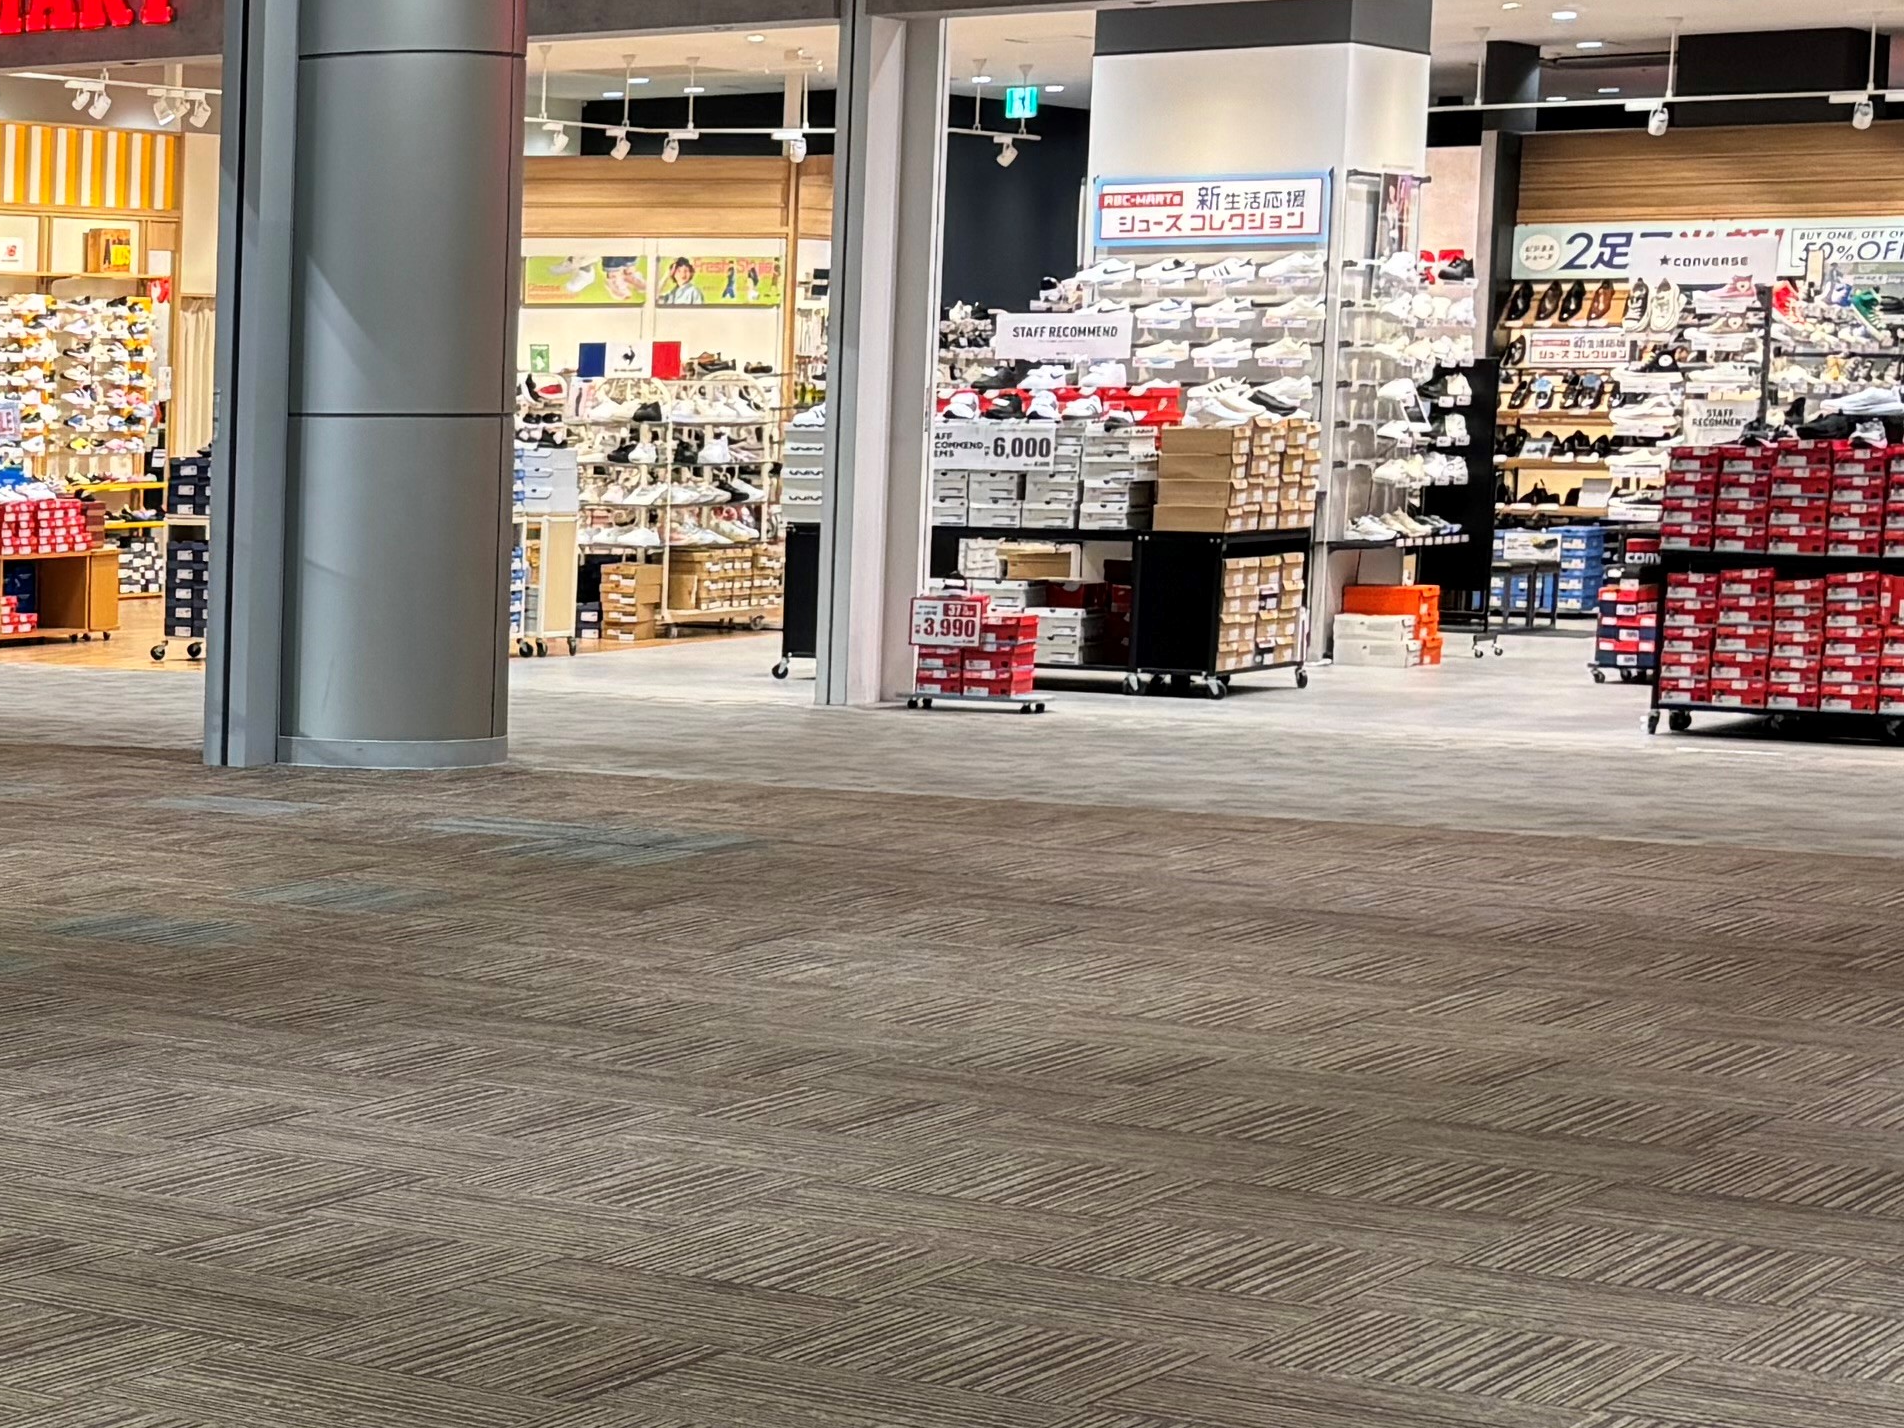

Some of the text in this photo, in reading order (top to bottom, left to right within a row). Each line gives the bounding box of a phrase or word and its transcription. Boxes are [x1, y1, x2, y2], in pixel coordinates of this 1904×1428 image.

[1195, 185, 1306, 212] 新生活応援
[1799, 231, 1822, 241] BUY
[1673, 255, 1749, 267] CONVERSE
[1012, 325, 1118, 338] STAFF RECOMMEND
[993, 437, 1052, 459] 6,000
[923, 617, 976, 639] 3,990
